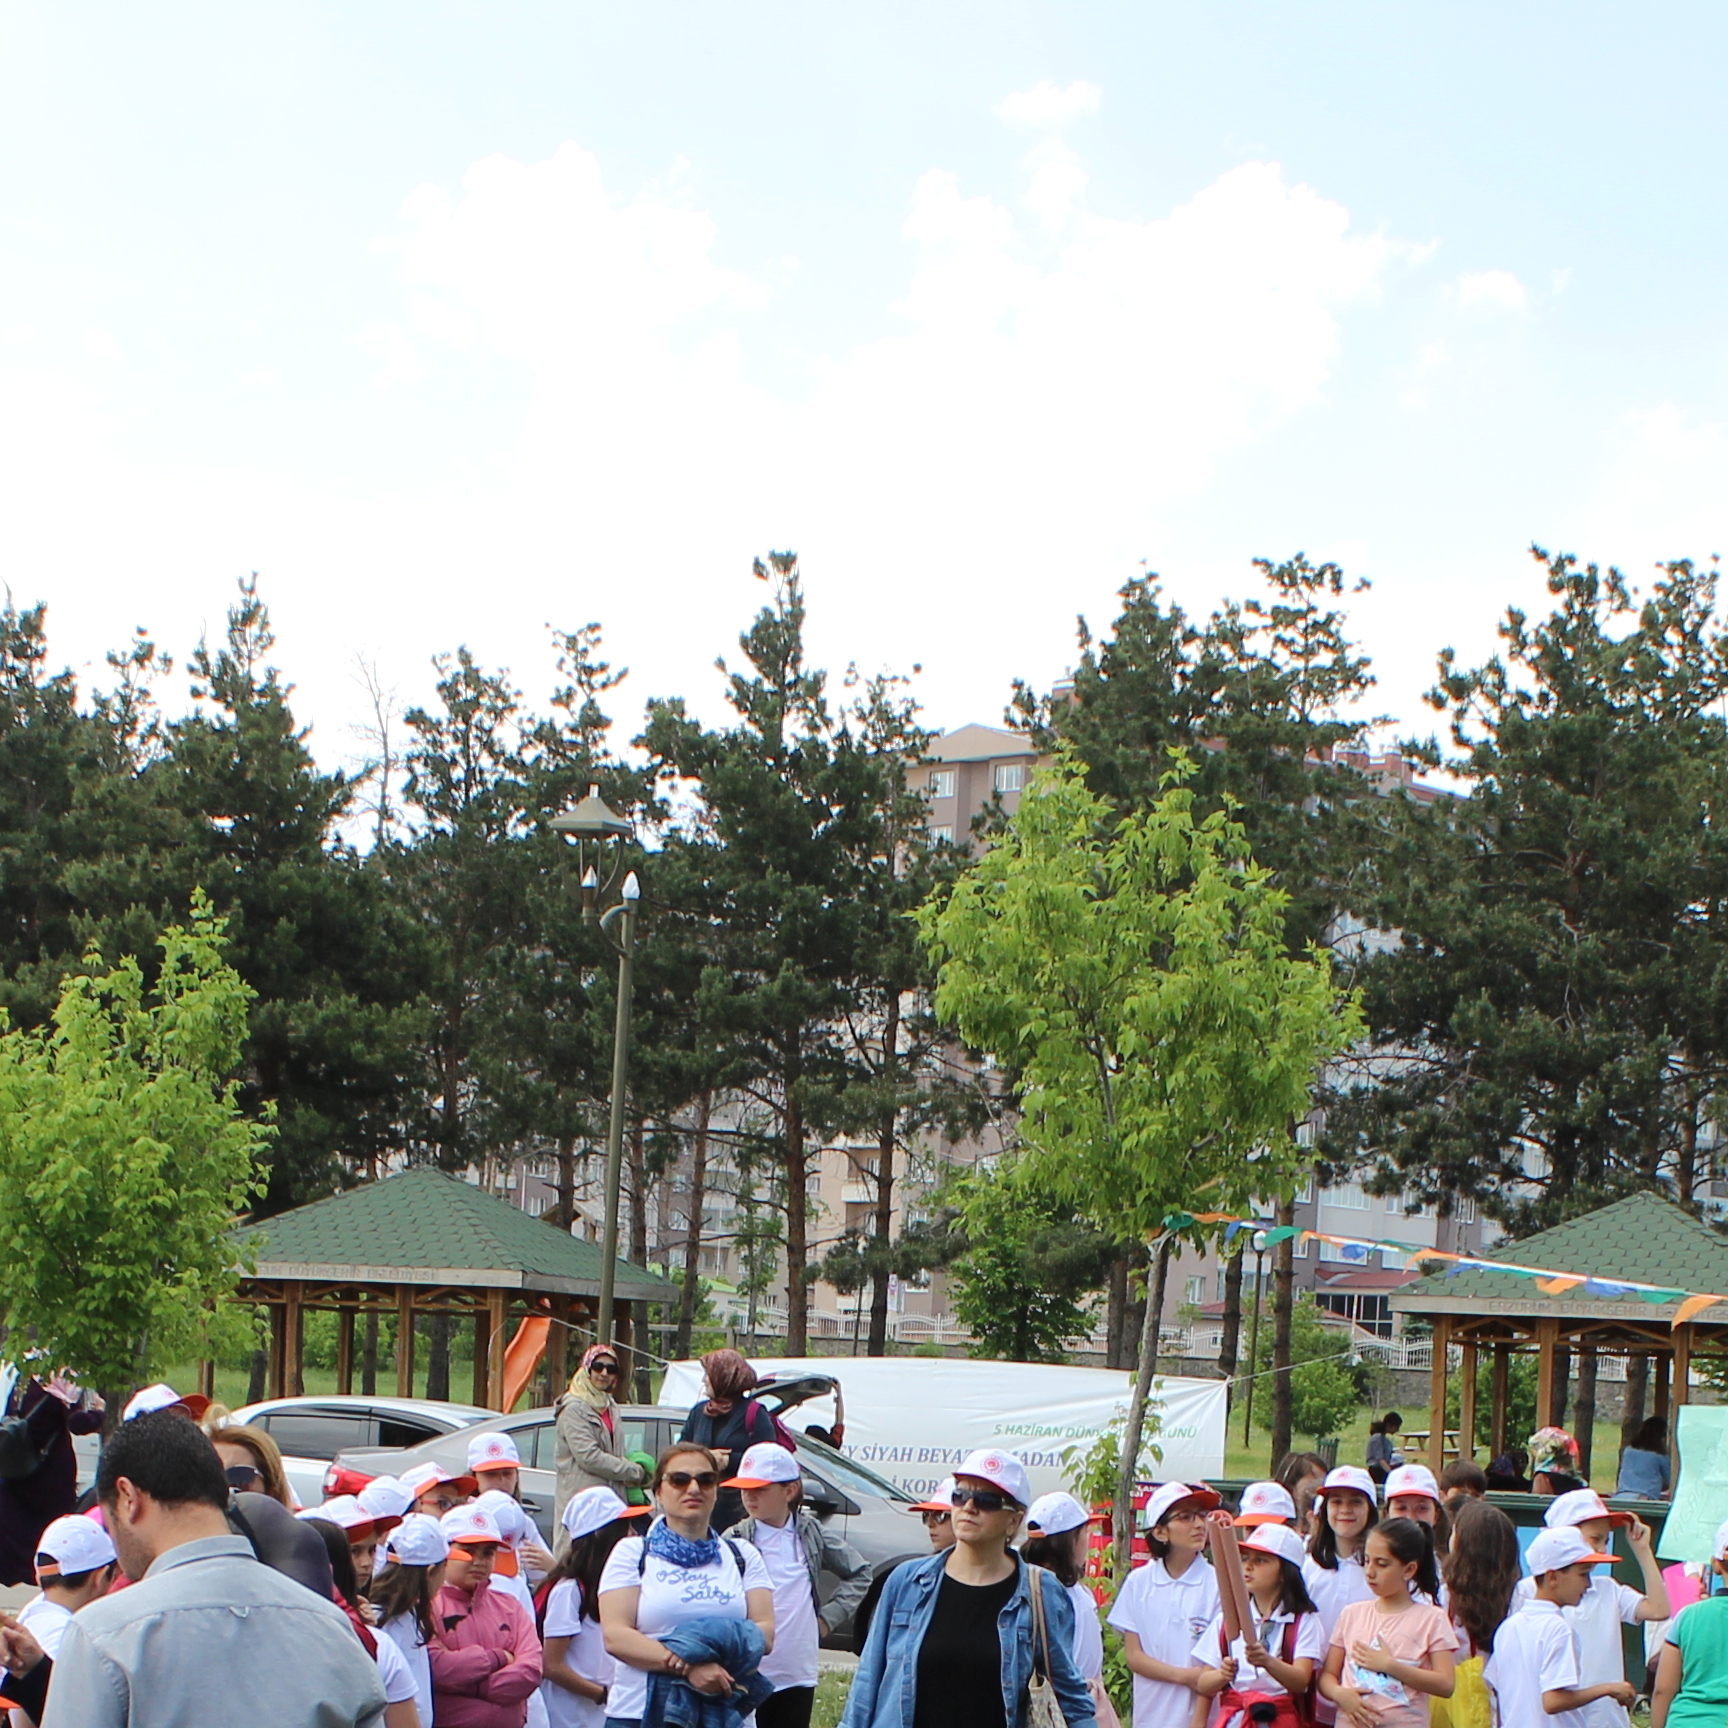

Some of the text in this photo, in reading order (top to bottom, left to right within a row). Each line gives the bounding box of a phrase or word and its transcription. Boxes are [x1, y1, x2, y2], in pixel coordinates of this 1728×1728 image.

[994, 1424, 1003, 1435] 5
[1005, 1423, 1064, 1438] HAZİRAN
[860, 1442, 914, 1463] SİYAH
[668, 1569, 718, 1589] Stay
[680, 1586, 736, 1605] Salty
